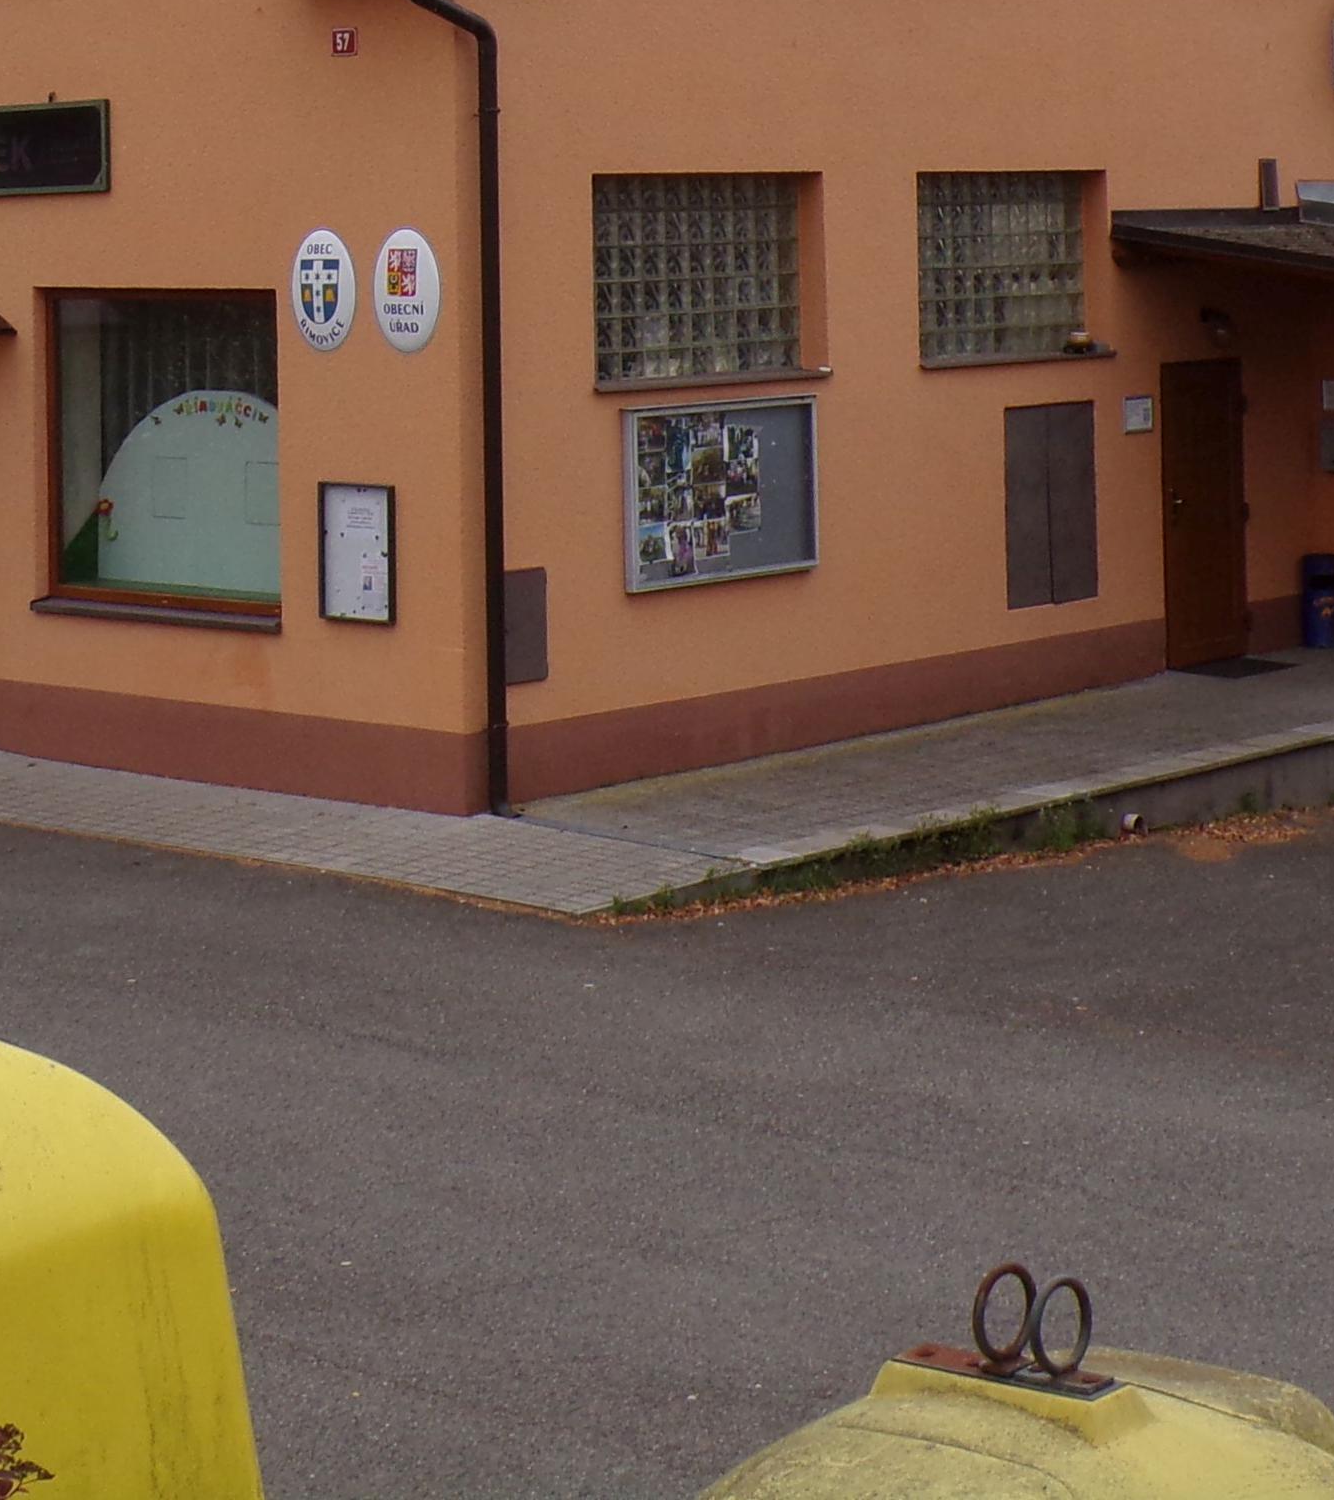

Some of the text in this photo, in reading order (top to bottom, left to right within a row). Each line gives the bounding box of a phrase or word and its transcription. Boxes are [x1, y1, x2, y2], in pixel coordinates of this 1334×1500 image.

[336, 32, 350, 51] 57
[307, 243, 333, 255] OBEC
[383, 300, 424, 316] OBECNÍ
[389, 319, 419, 333] ÚŘAD
